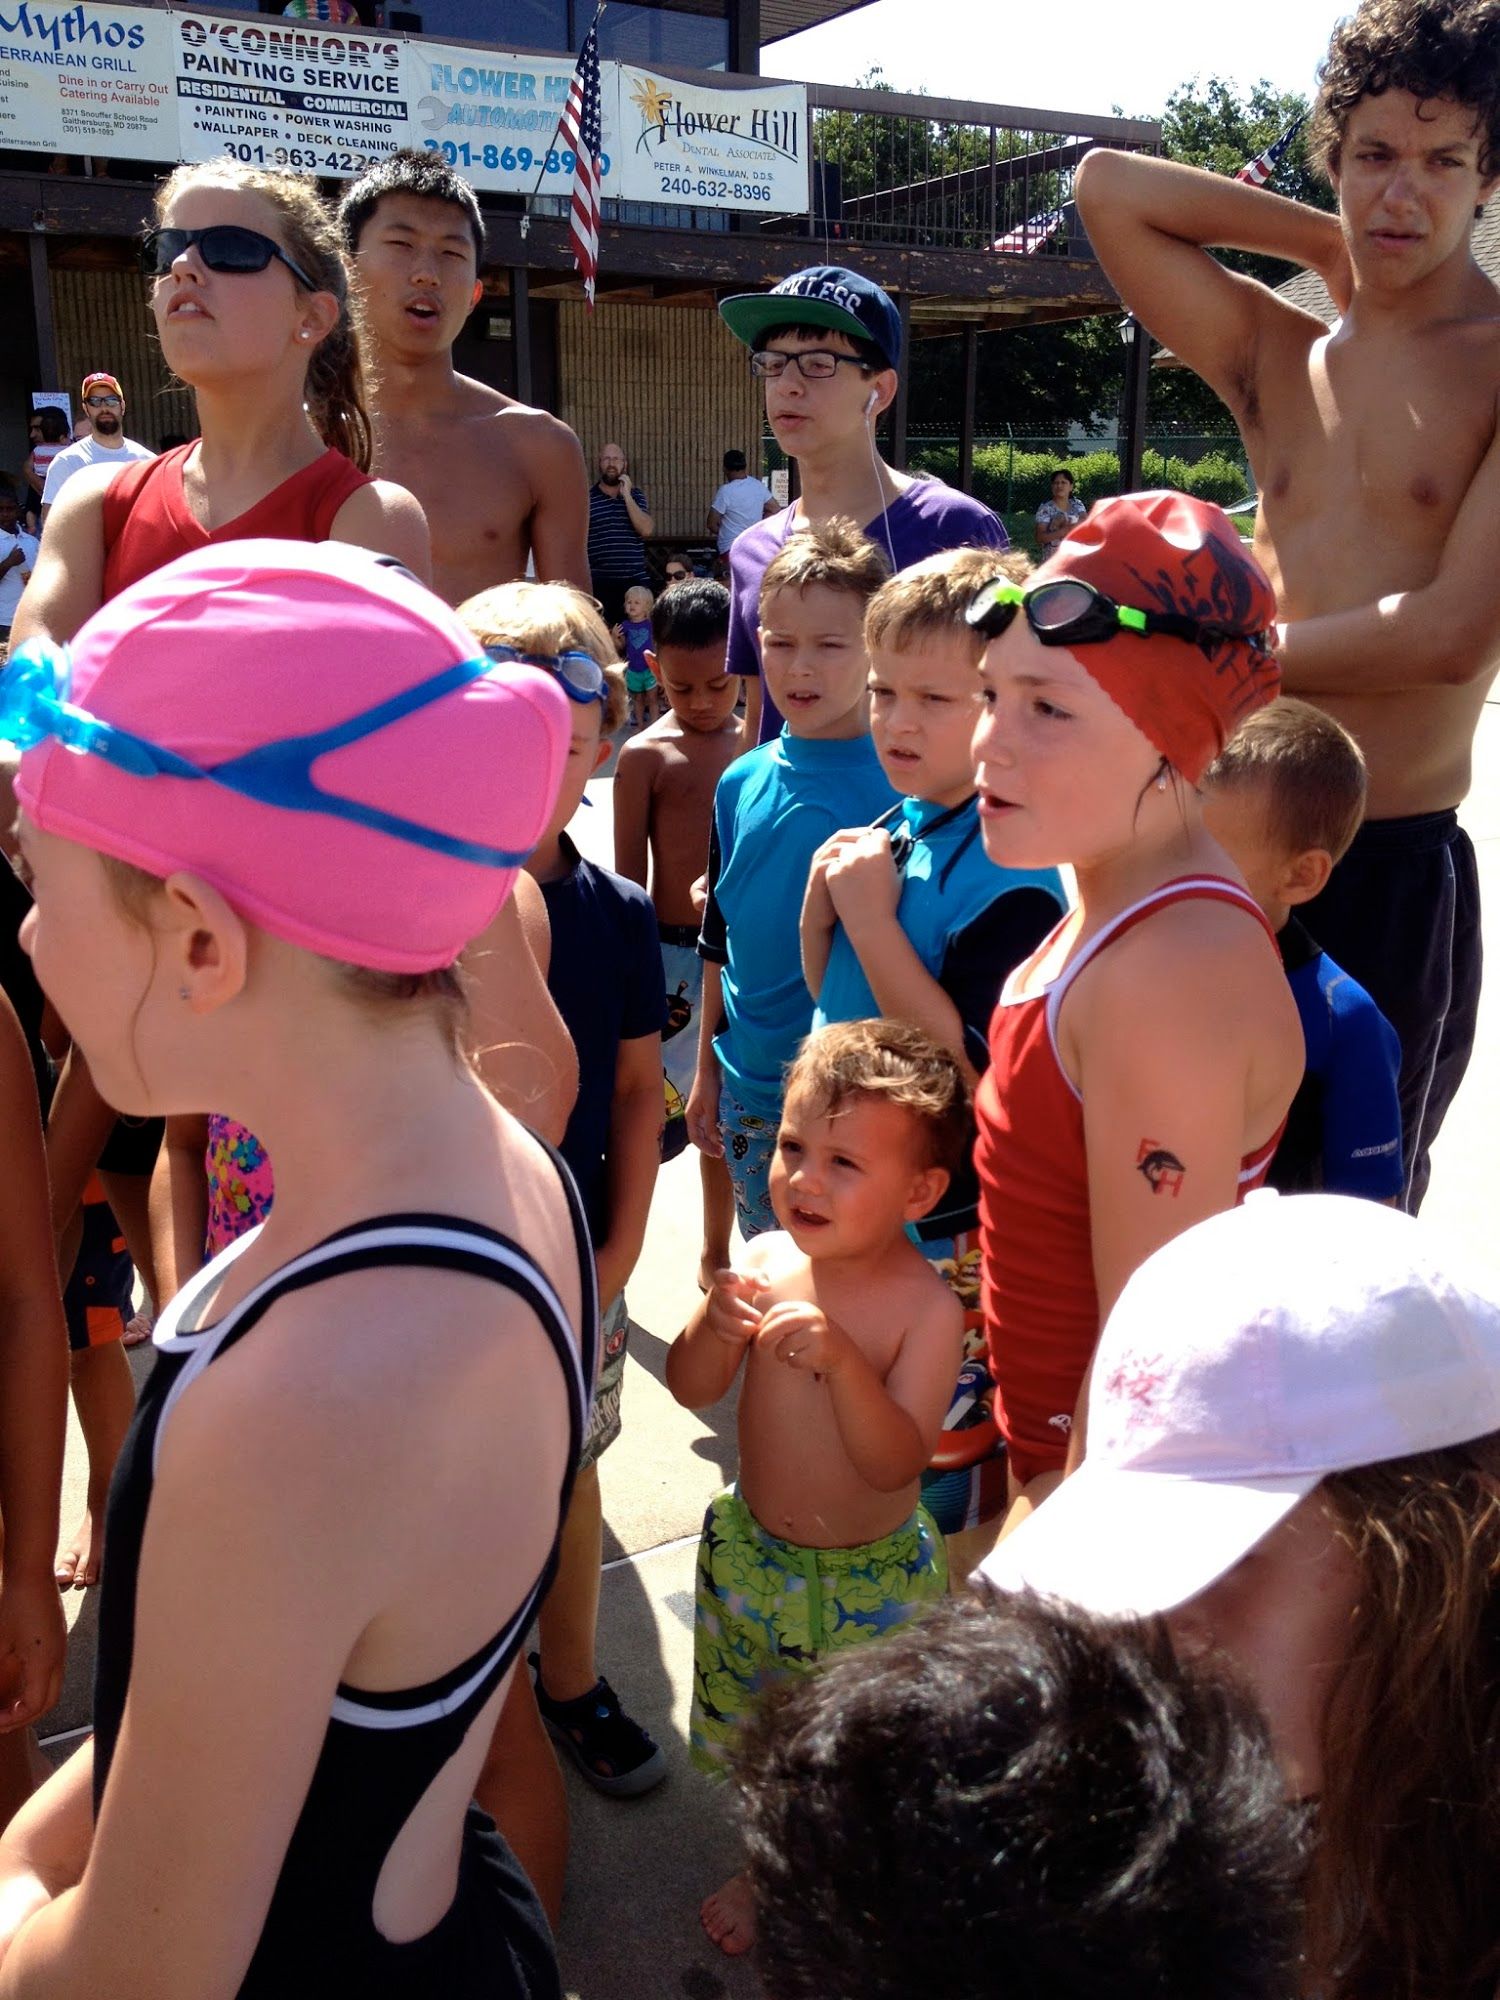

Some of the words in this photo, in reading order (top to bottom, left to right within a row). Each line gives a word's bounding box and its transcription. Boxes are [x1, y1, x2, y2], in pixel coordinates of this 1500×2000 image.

[0, 2, 145, 50] Mythos
[0, 46, 87, 67] ERRANEAN
[92, 56, 137, 72] GRILL
[180, 19, 400, 70] O'CONNOR'S
[59, 74, 84, 86] Dine
[87, 77, 98, 87] in
[101, 80, 112, 89] or
[116, 80, 145, 94] Carry
[148, 84, 168, 94] Out
[182, 52, 295, 84] PAINTING
[303, 68, 400, 94] SERVICE
[431, 63, 537, 101] FLOWER
[544, 76, 571, 104] HI
[60, 87, 107, 103] Catering
[111, 92, 160, 106] Available
[179, 80, 286, 105] RESIDENTIAL
[303, 96, 406, 116] COMMERCIAL
[63, 126, 80, 134] (301)
[114, 112, 138, 122] School
[140, 116, 158, 124] Road
[205, 105, 267, 121] PAINTING
[286, 114, 330, 128] POWER
[334, 120, 392, 134] WASHING
[448, 102, 561, 132] AUTOMOTI
[656, 99, 741, 145] Flower
[751, 108, 798, 158] Hill
[202, 121, 279, 139] WALLPAPER
[298, 134, 332, 146] DECK
[337, 137, 398, 152] CLEANING
[424, 139, 610, 176] 301-869-890
[682, 142, 720, 157] DENTAL
[726, 148, 776, 161] ASSOCIATES
[654, 161, 681, 172] PETER
[684, 164, 692, 174] A.
[698, 166, 749, 180] WINKELMAN,
[753, 171, 775, 181] D.D.S.
[661, 176, 771, 201] 240-632-8396
[1155, 1170, 1184, 1198] H
